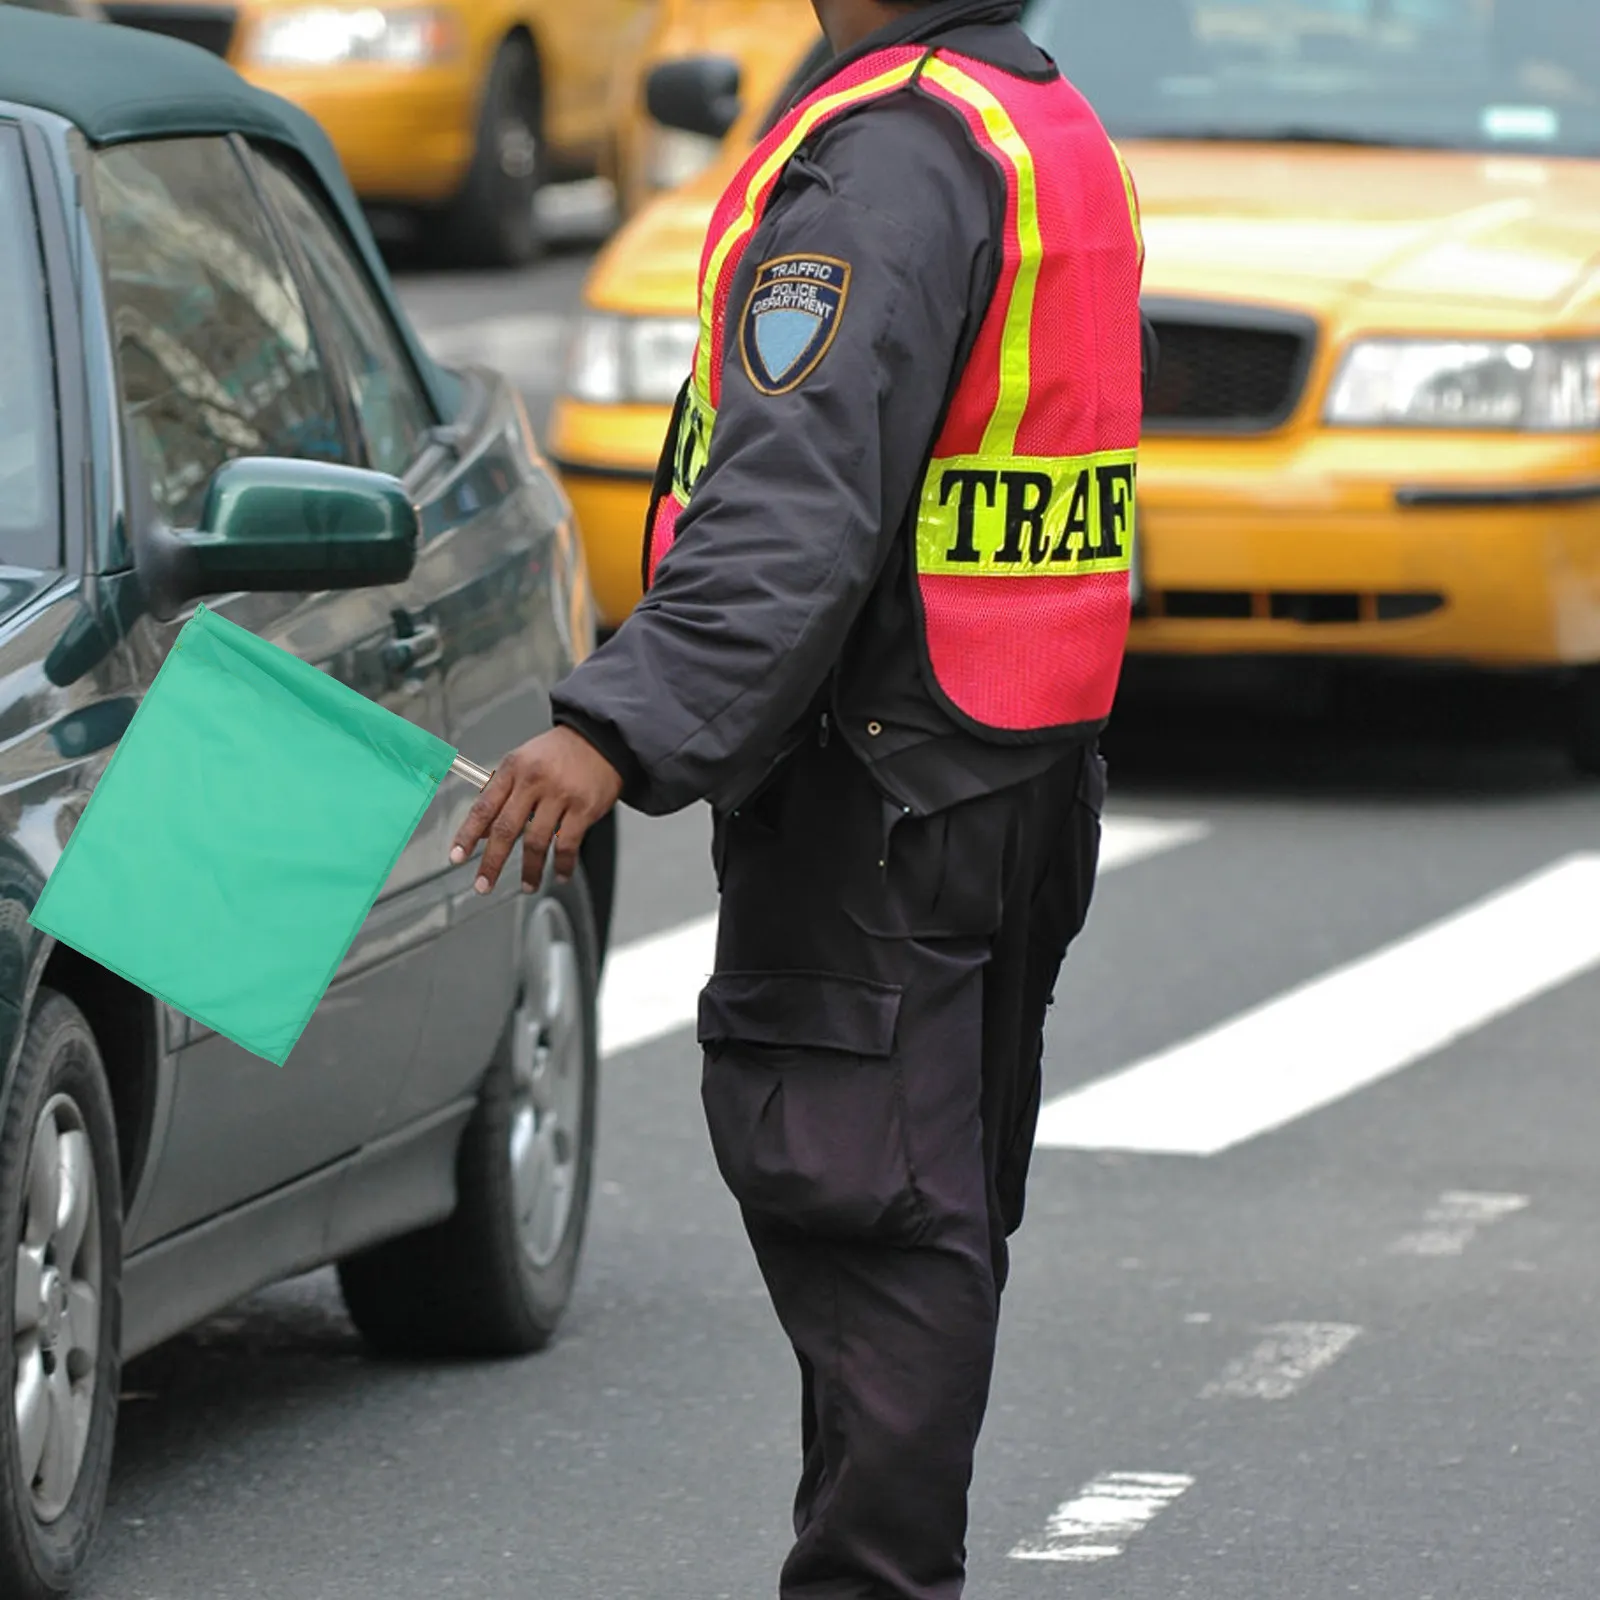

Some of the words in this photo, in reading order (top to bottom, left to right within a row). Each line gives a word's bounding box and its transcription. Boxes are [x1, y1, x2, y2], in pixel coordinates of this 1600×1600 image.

[770, 261, 832, 280] TRAFFIC
[770, 283, 818, 299] POLICE
[751, 294, 834, 319] DEPARTMENT
[938, 462, 1137, 564] TRAF
